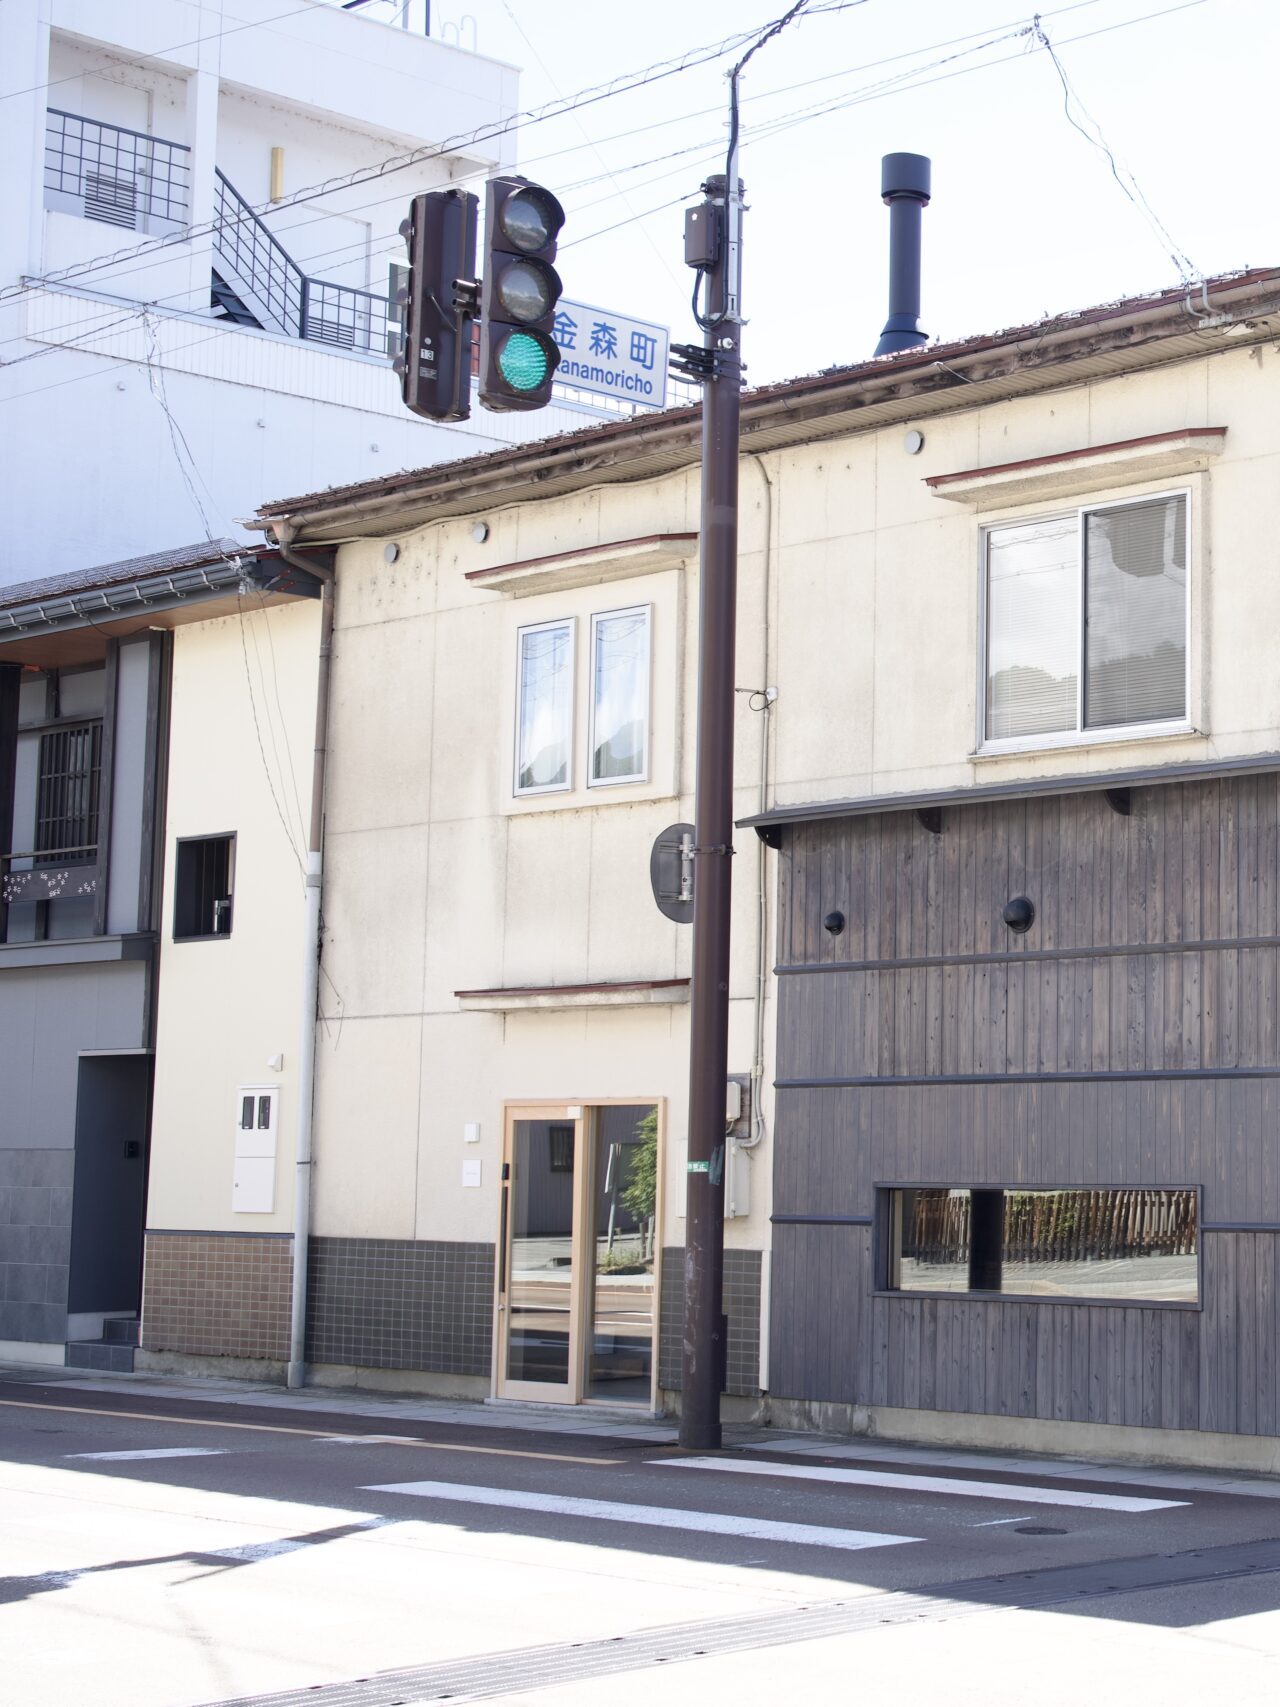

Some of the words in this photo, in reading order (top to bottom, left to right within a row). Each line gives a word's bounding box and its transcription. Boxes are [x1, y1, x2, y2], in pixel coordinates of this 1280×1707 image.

[553, 312, 658, 371] 金森町
[556, 359, 653, 395] anamoricho
